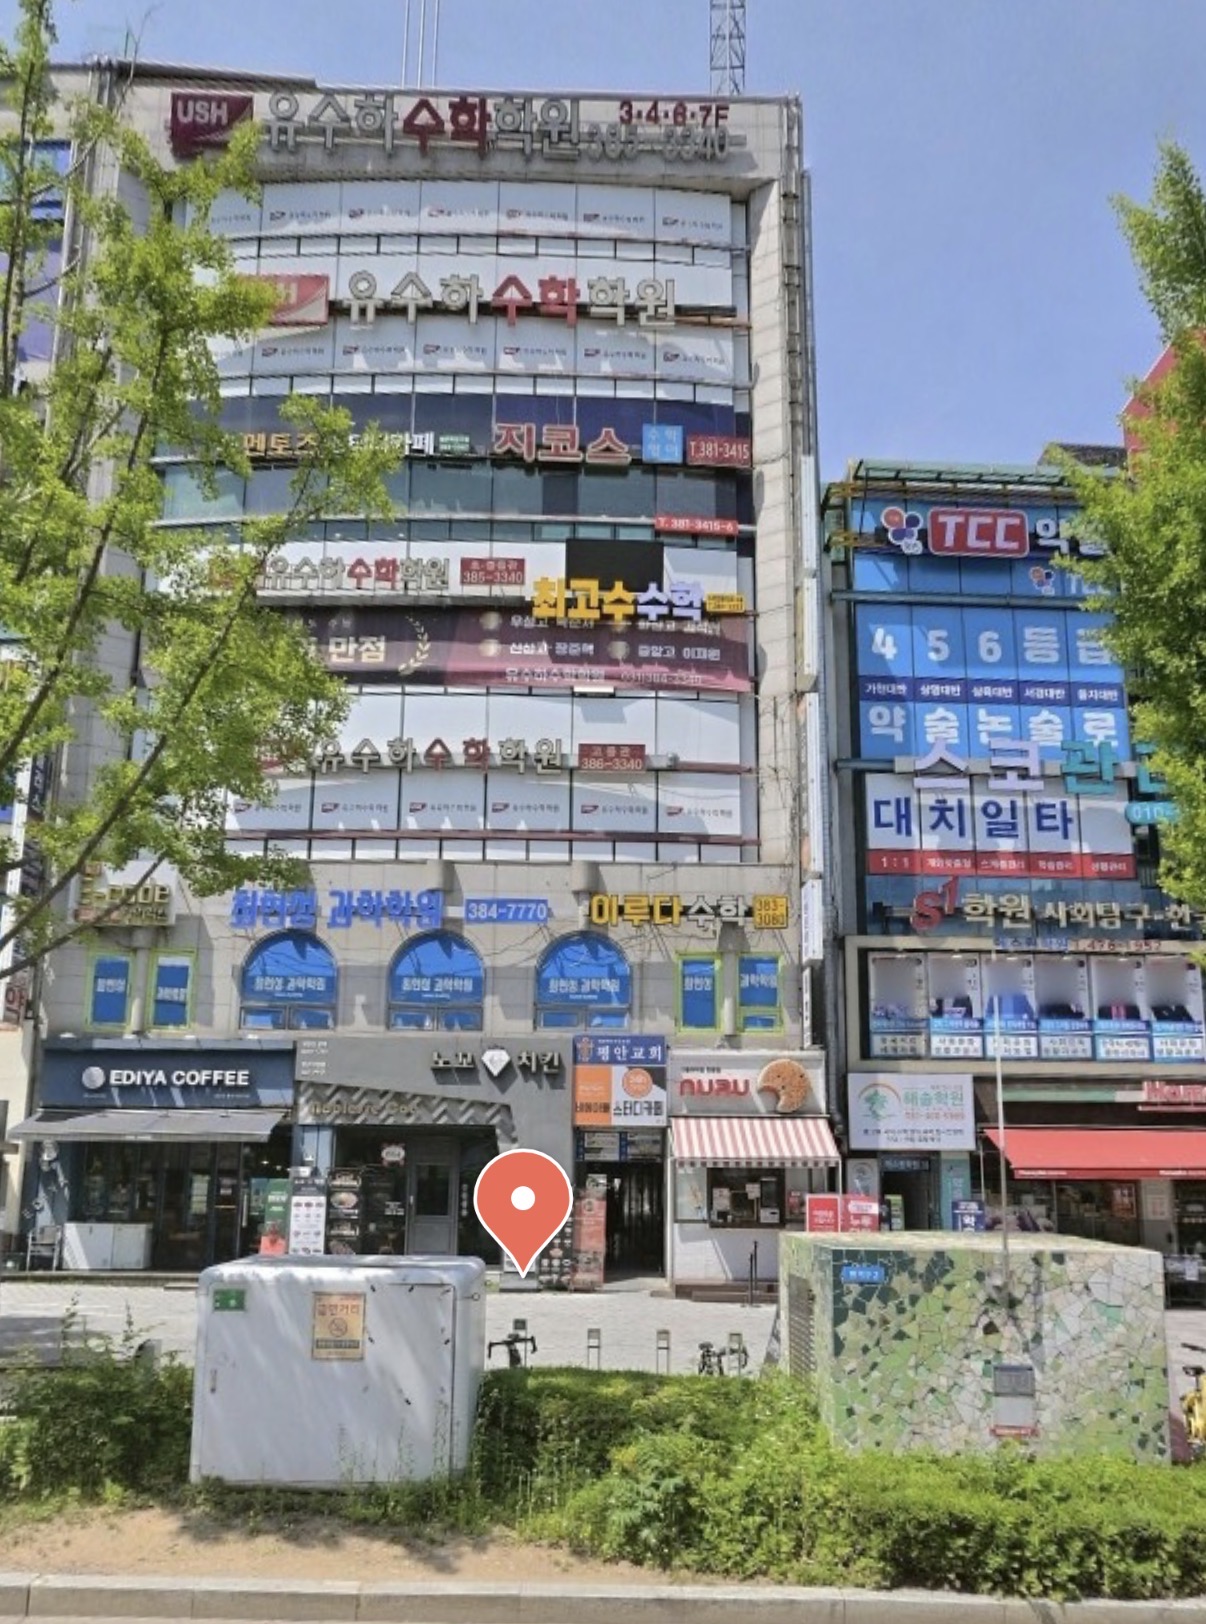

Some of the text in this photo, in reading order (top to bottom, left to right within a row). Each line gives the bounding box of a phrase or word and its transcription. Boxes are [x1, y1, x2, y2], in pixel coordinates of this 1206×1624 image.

[176, 100, 229, 126] USH
[494, 423, 632, 463] 지코스
[937, 514, 1020, 549] TCC
[467, 903, 548, 920] 384-7770
[961, 893, 1033, 929] 학원
[517, 1051, 560, 1074] 치킨
[597, 1044, 662, 1062] 평안교회
[109, 1069, 250, 1087] EDIYA COFFEE
